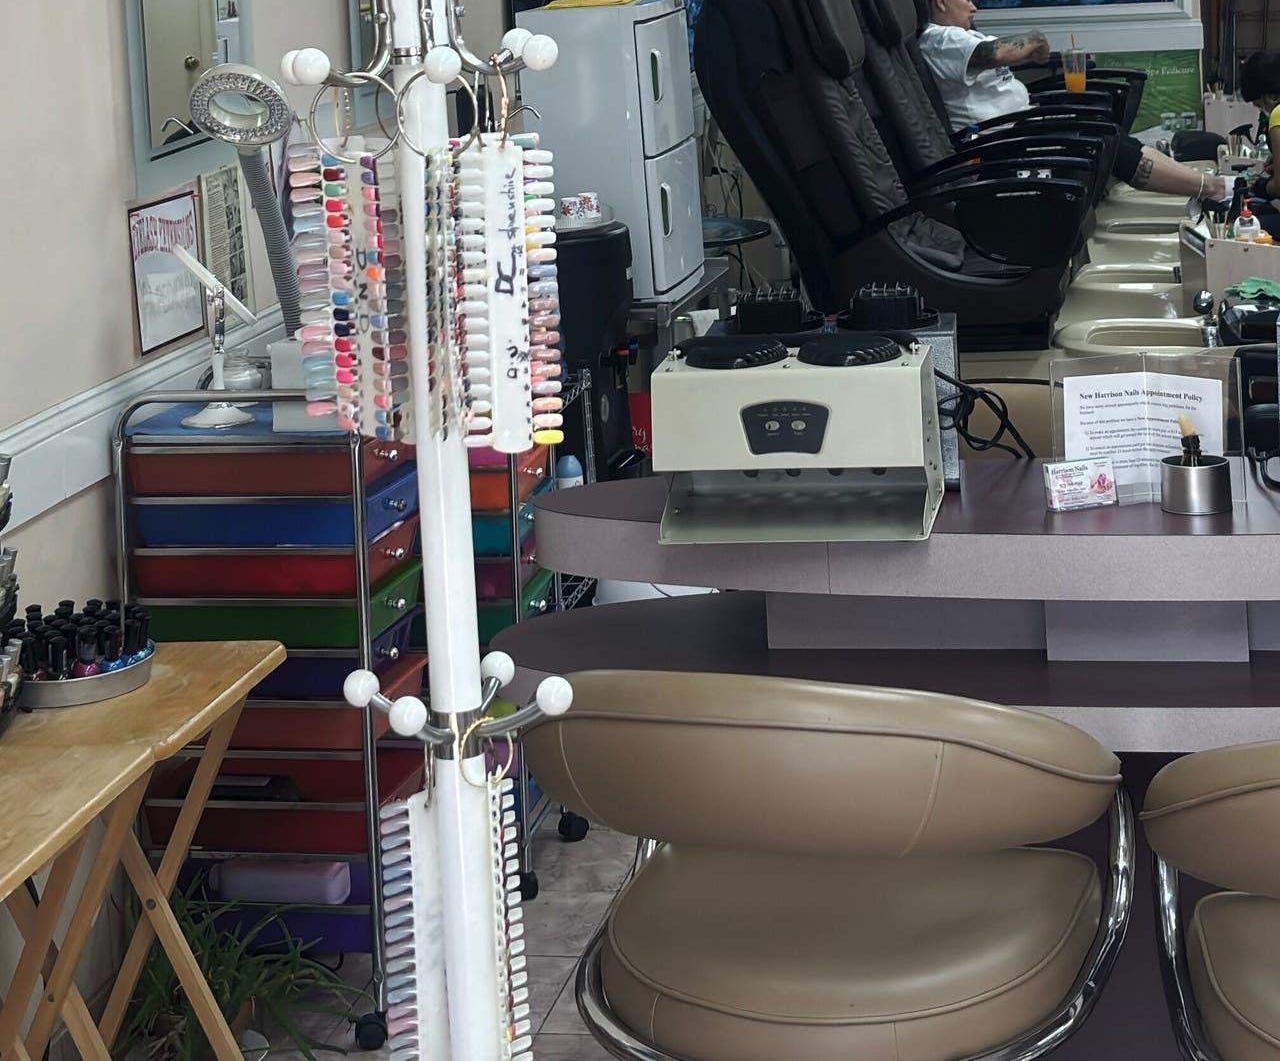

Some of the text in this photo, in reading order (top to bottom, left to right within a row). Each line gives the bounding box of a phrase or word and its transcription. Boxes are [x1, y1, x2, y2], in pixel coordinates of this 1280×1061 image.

[1095, 391, 1123, 399] Harrison
[1124, 389, 1140, 397] Nails
[1141, 389, 1182, 399] Appointment
[1183, 392, 1203, 402] Policy
